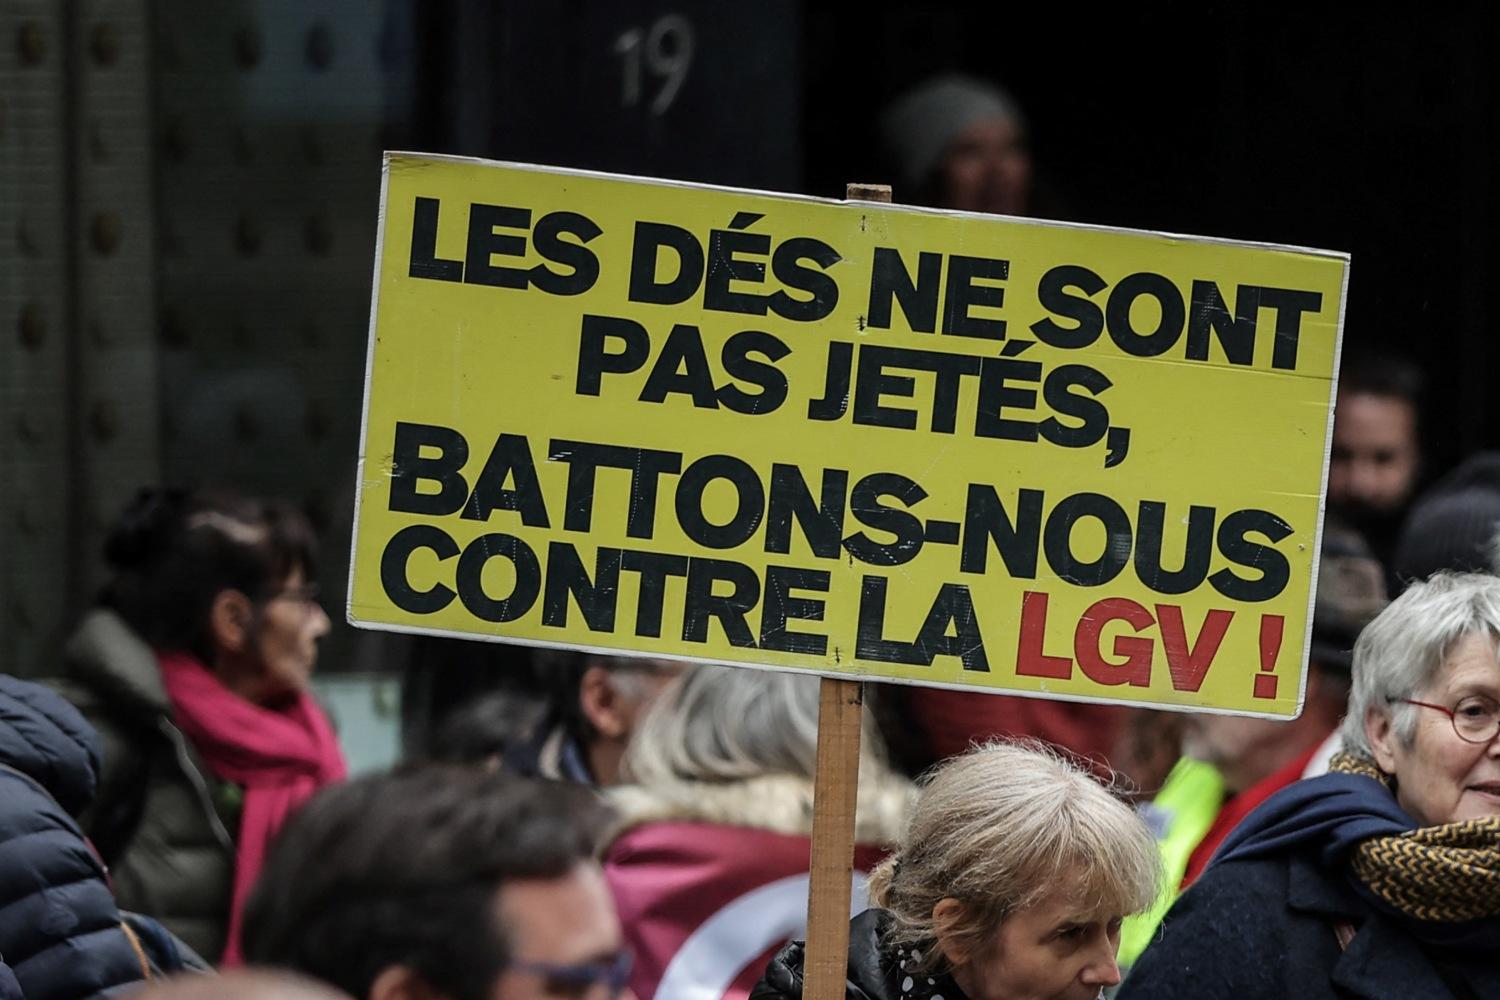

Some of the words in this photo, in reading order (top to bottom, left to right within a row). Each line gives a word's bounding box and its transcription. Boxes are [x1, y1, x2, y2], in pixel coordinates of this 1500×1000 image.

[615, 15, 694, 116] 19
[409, 197, 603, 297] LES
[628, 212, 842, 322] DÉS
[867, 247, 1010, 341] NE
[1029, 265, 1323, 370] SONT
[576, 314, 792, 416] PAS
[808, 340, 1130, 468] JETÉS,
[388, 422, 1294, 602] BATTONS-NOUS
[381, 525, 831, 656] CONTRE
[855, 575, 990, 673] LA
[1015, 591, 1235, 693] LGV
